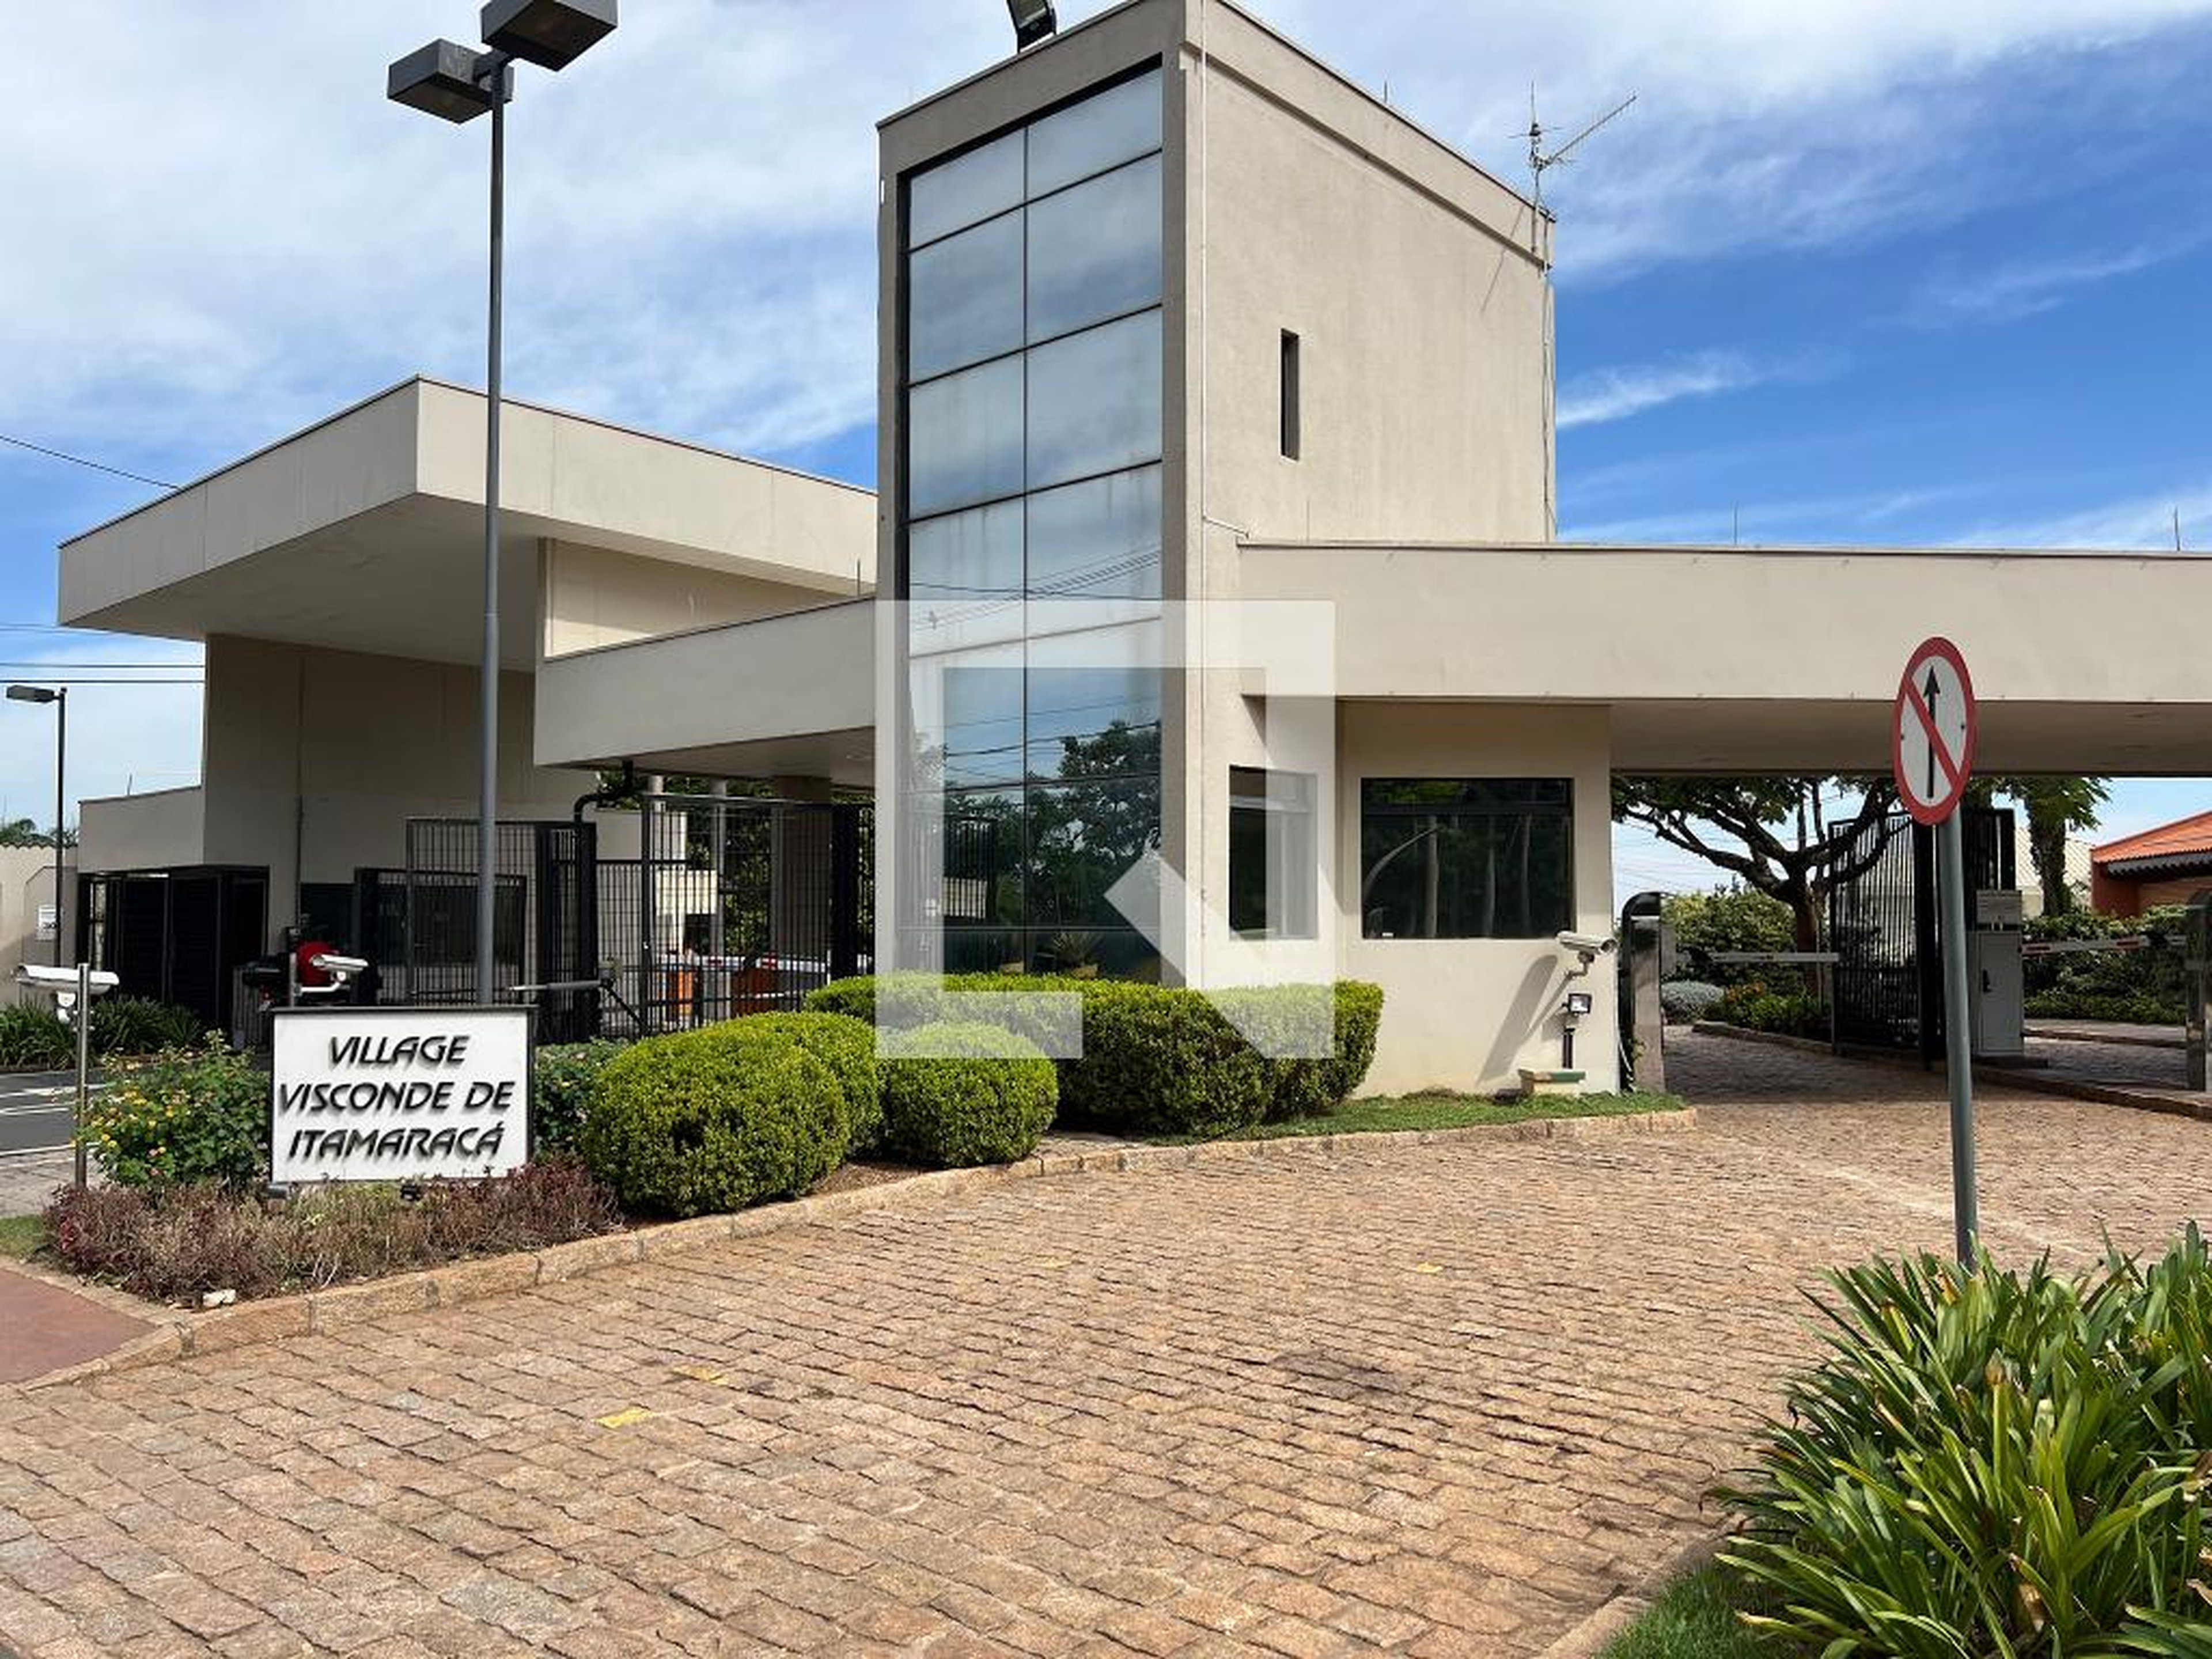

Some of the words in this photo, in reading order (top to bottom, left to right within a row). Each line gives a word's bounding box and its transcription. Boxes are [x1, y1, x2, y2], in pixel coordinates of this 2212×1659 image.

[330, 1036, 469, 1065] VILLAGE
[280, 1081, 454, 1112] VISCONDE
[464, 1081, 516, 1110] DE
[288, 1122, 505, 1160] ITAMARACÁ
